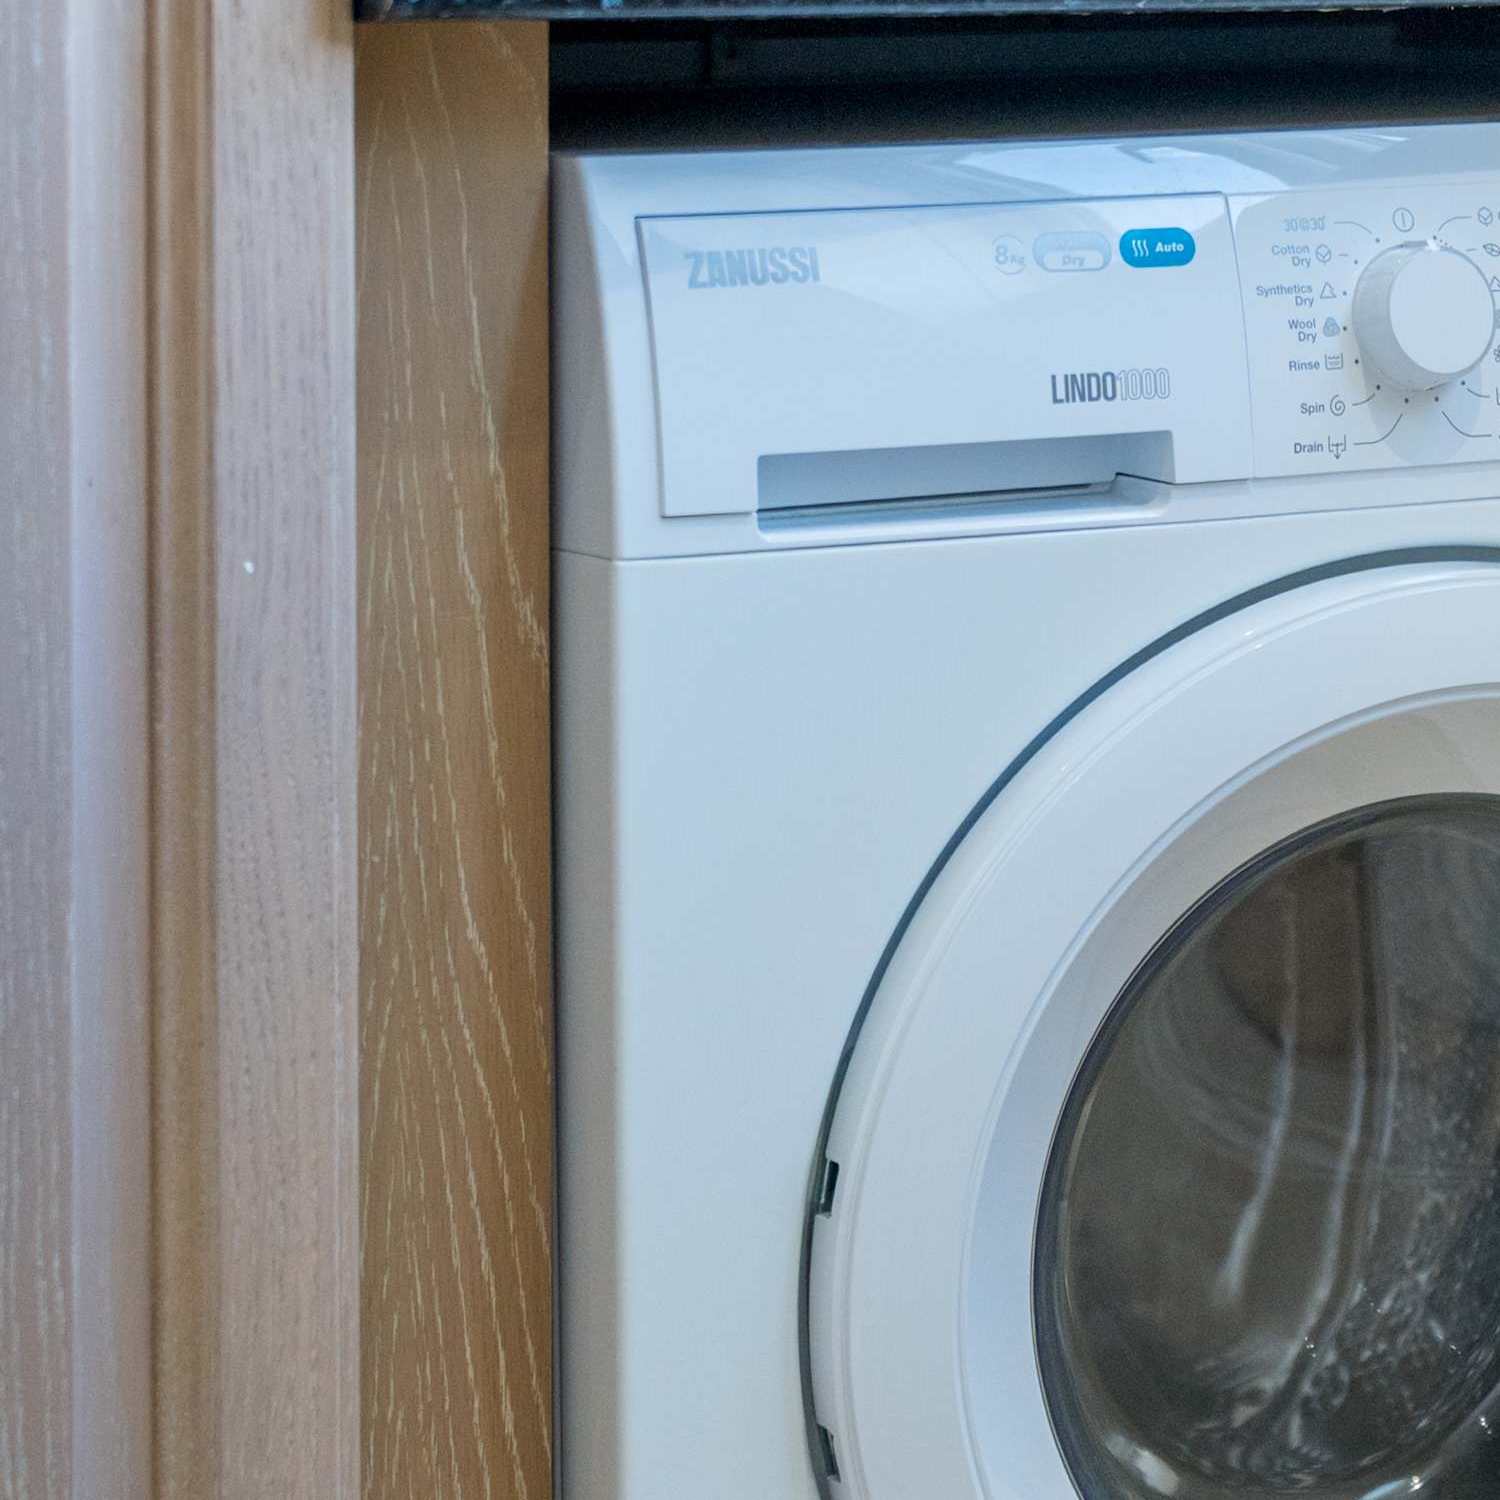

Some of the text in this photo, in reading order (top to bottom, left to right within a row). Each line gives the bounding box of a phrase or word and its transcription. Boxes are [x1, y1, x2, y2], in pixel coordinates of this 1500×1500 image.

[1154, 241, 1185, 253] Auto
[1271, 244, 1310, 256] Cotton
[684, 246, 821, 290] ZANUSSI
[1292, 256, 1312, 268] Dry
[1256, 283, 1313, 297] Synthetics
[1295, 296, 1314, 307] Dry
[1288, 318, 1316, 330] Wool
[1298, 332, 1317, 344] Dry
[1288, 360, 1321, 371] Rinse
[1300, 403, 1325, 416] Spin
[1294, 441, 1324, 454] Drain
